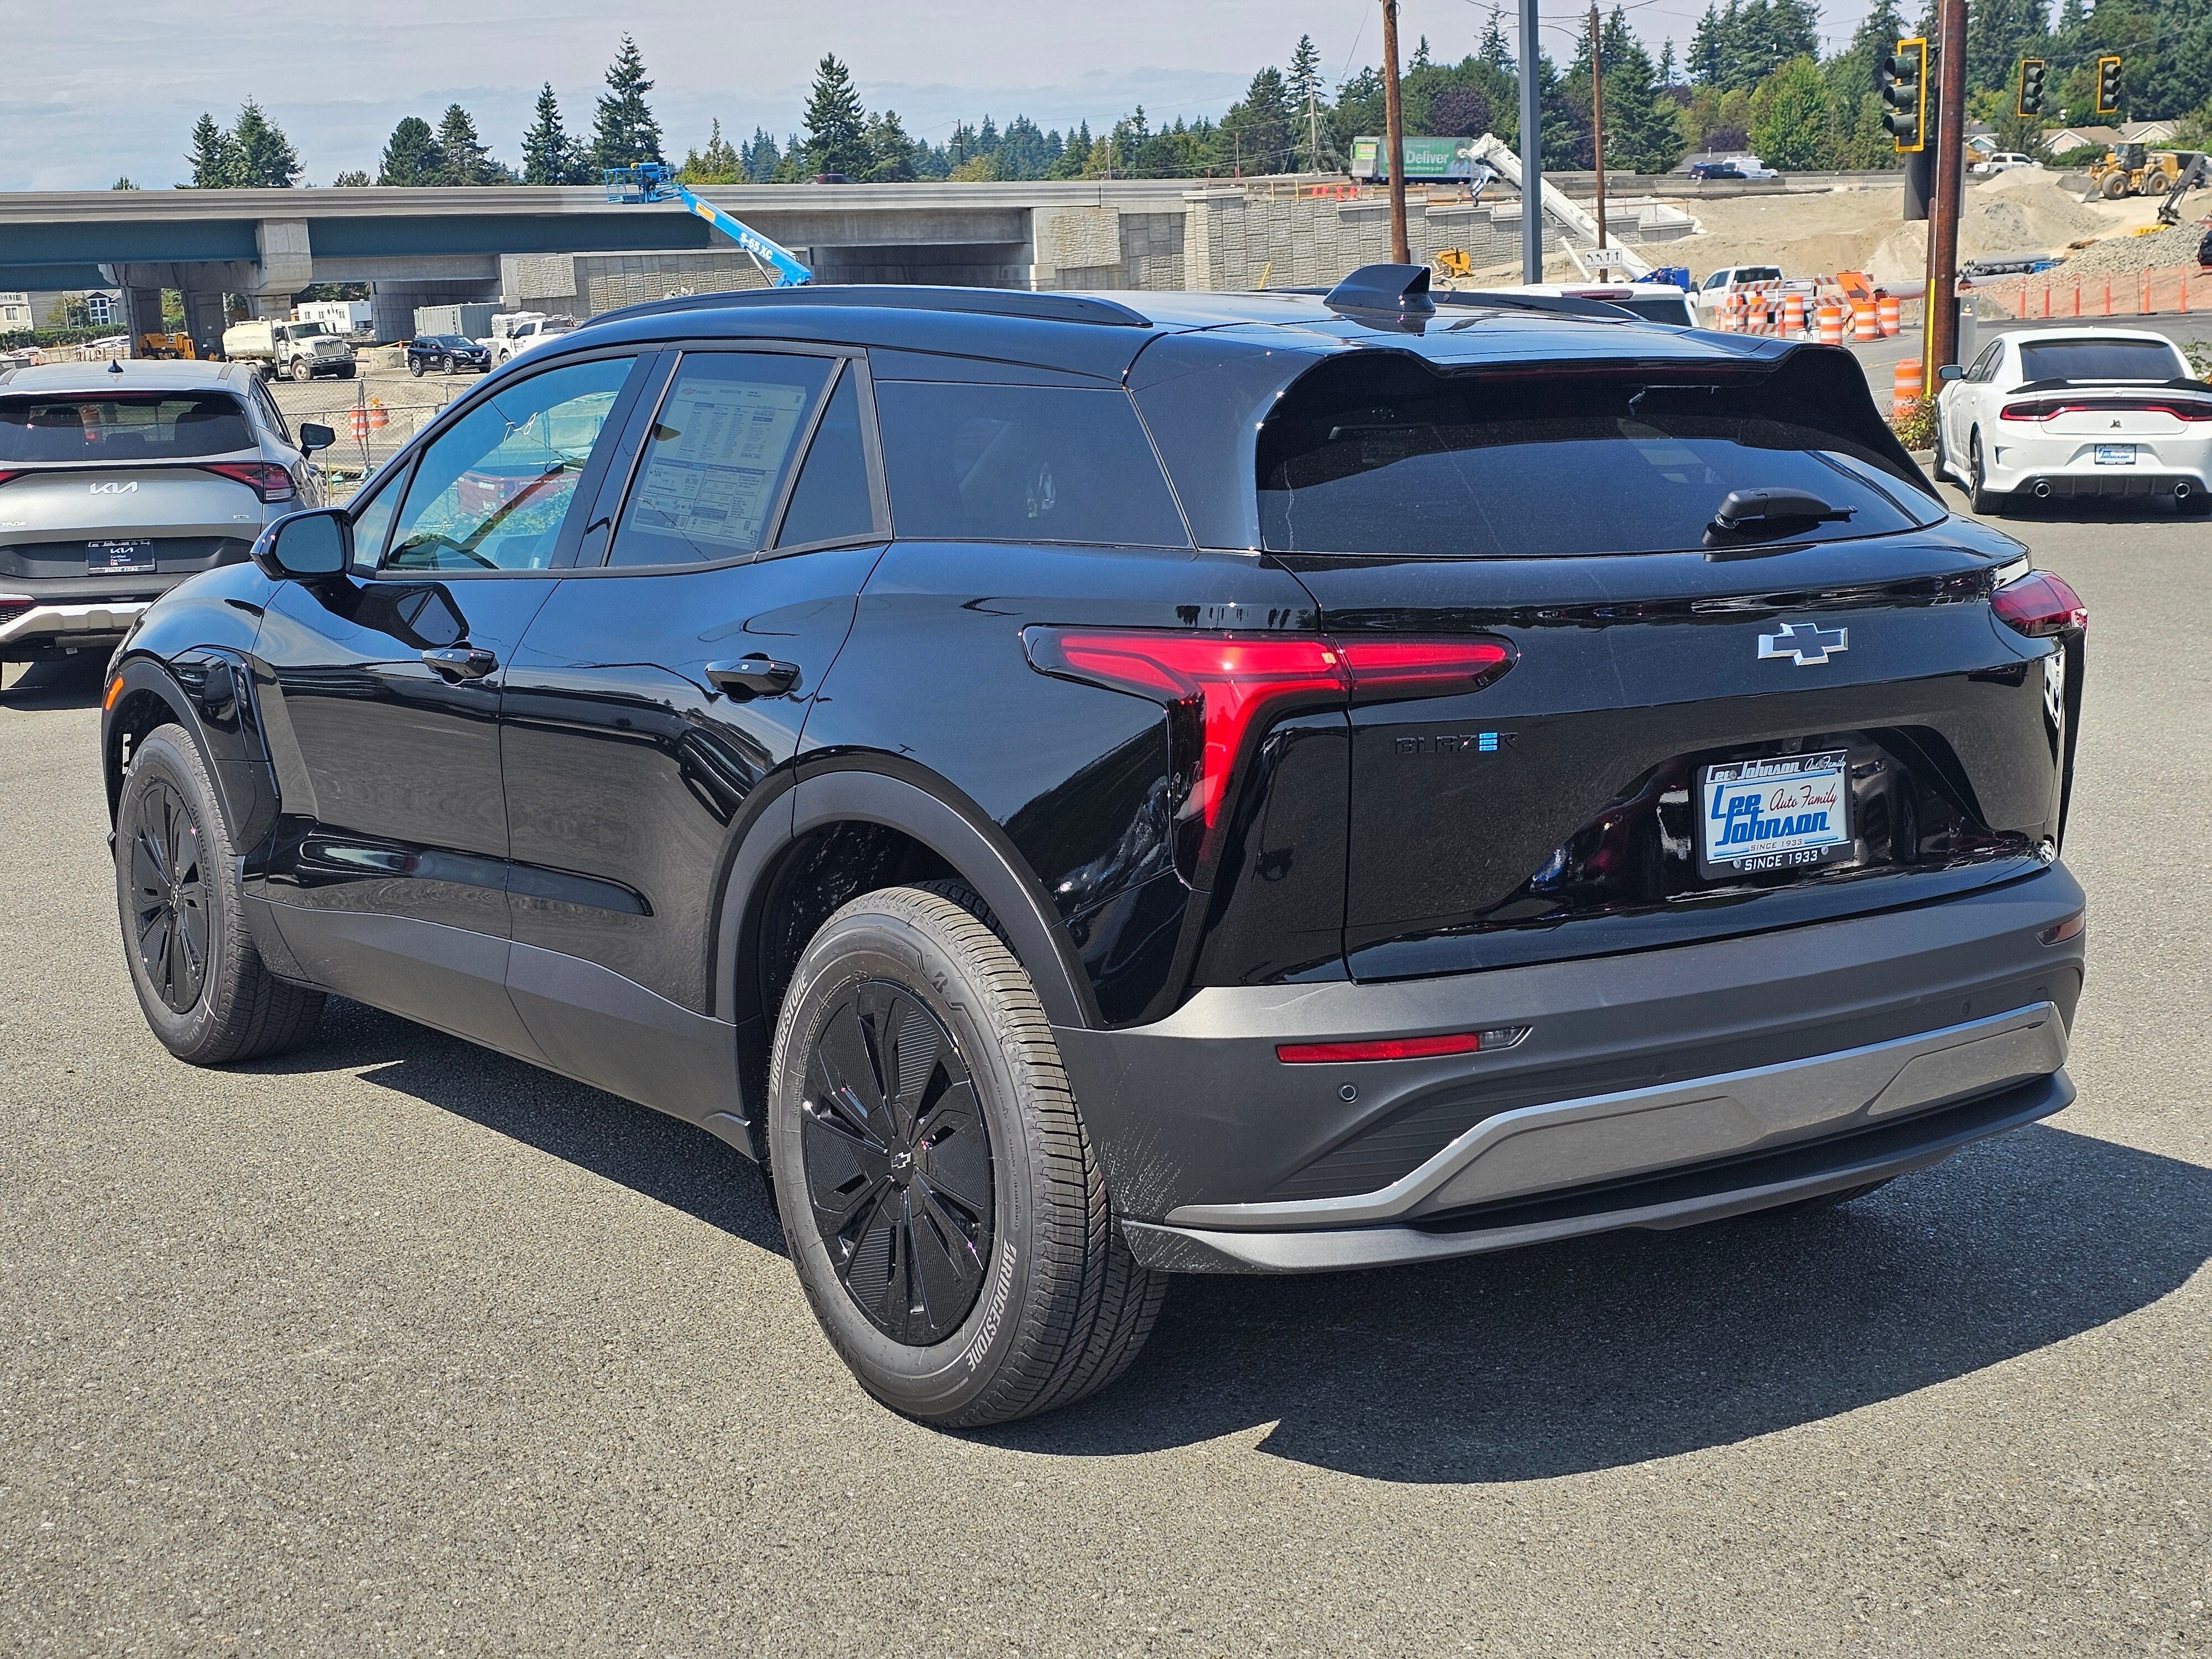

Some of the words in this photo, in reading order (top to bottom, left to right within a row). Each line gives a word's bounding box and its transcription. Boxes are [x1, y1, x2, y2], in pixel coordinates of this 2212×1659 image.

[1405, 149, 1449, 165] Deliver
[740, 232, 760, 252] S-65
[759, 245, 773, 260] XC
[90, 481, 138, 494] KIA
[1395, 732, 1519, 754] BLAZER
[1737, 760, 1801, 780] Johnson
[1823, 754, 1846, 773] Family
[1711, 784, 1764, 820] Lee
[1770, 788, 1798, 811] Auto
[1799, 782, 1837, 812] Family
[1715, 806, 1830, 847] Johnson
[191, 804, 213, 901] BRIDGESTONE
[1751, 841, 1777, 851] SINCE
[1781, 838, 1803, 847] 1933
[1745, 855, 1782, 871] SINCE
[1788, 850, 1818, 865] 1933
[771, 969, 808, 1097] BRIDGESTONE
[966, 1237, 1018, 1373] BRIDGESTONE
